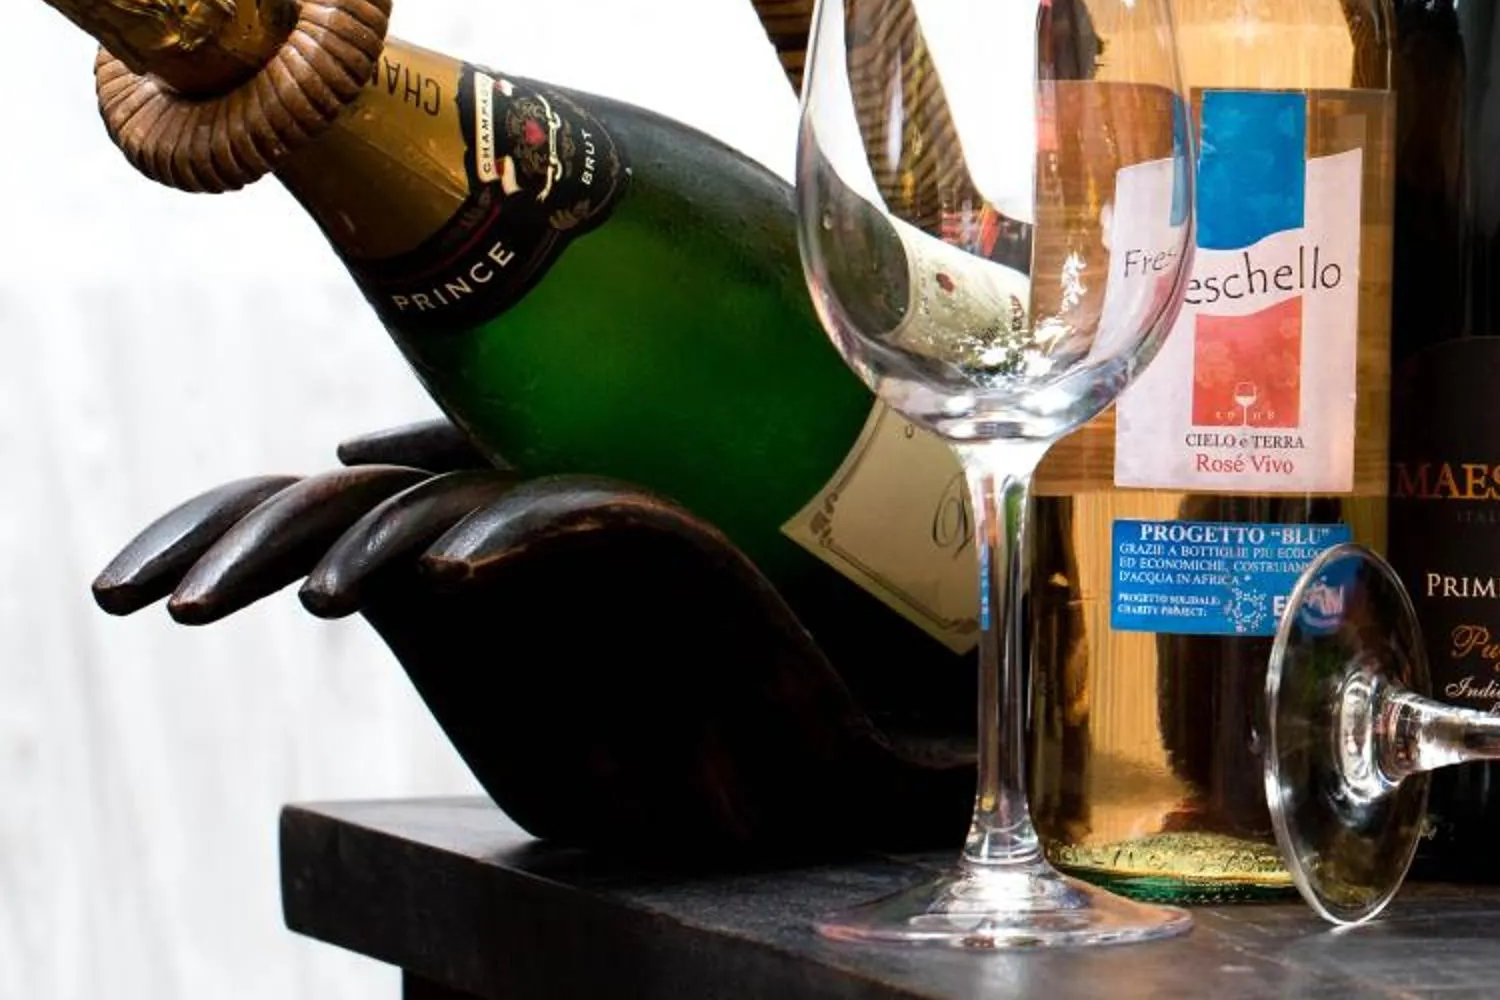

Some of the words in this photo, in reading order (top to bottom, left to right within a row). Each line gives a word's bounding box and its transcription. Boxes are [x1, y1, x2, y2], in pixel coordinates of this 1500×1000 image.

[580, 129, 597, 186] BRUT
[391, 241, 515, 312] PRINCE
[1184, 432, 1236, 449] CIELO
[1250, 434, 1305, 450] TERRA
[1195, 452, 1245, 474] Rosé
[1250, 454, 1294, 475] Vivo
[1139, 524, 1265, 545] PROGETTO
[1119, 543, 1164, 555] GRAZIE
[1168, 545, 1178, 556] A
[1181, 545, 1249, 558] BOTTIGLIE
[1119, 556, 1136, 568] ED
[1176, 573, 1192, 584] IN
[1192, 573, 1240, 586] AFRICA
